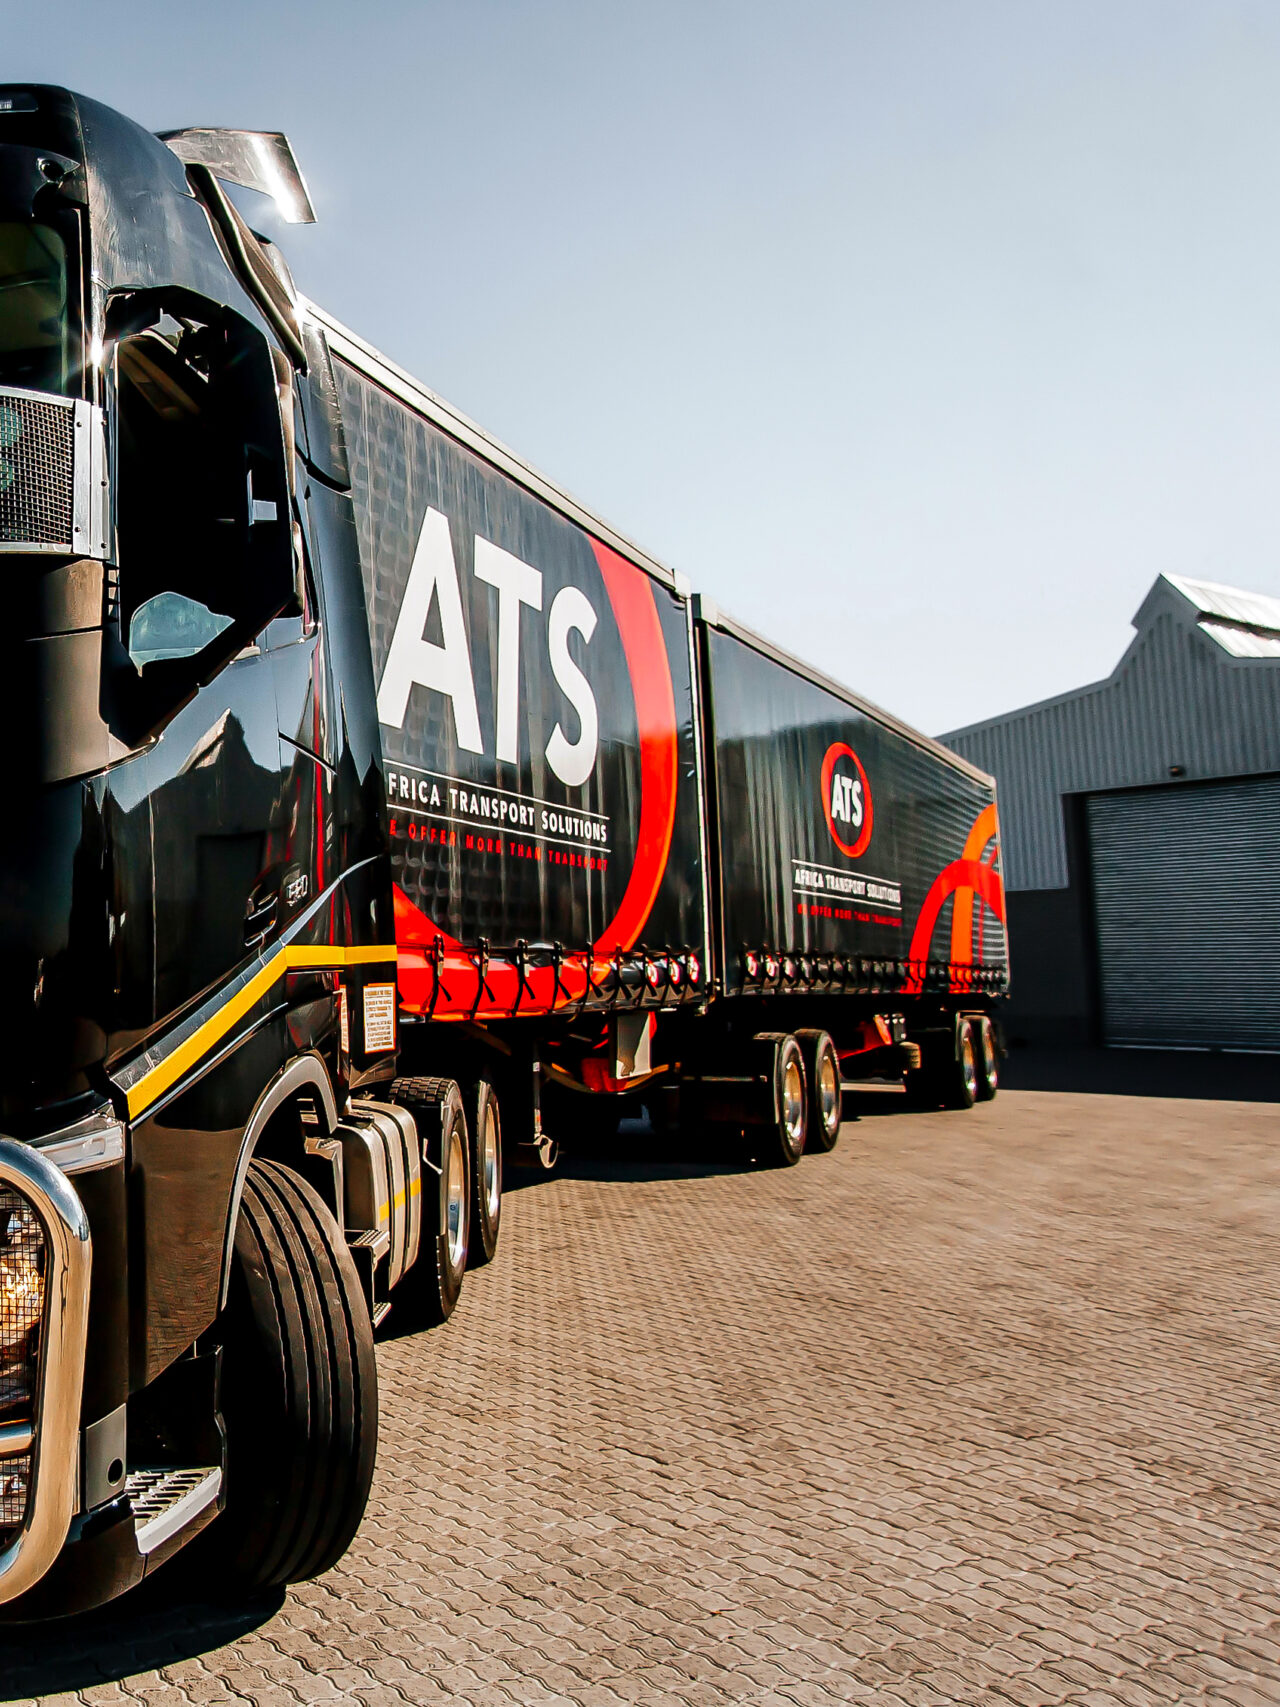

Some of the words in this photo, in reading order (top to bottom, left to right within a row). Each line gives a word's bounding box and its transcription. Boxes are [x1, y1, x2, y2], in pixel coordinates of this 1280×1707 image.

[377, 505, 598, 786] ATS
[388, 773, 440, 807] FRICA
[449, 788, 535, 827] TRANSPORT
[541, 810, 608, 843] SOLUTIONS
[831, 773, 863, 827] ATS
[389, 819, 397, 836] E
[408, 823, 456, 847] OFFER
[466, 834, 502, 854] MORE
[510, 842, 542, 861] THAN
[548, 850, 608, 872] TRANSPORT
[795, 869, 824, 888] AFRICA
